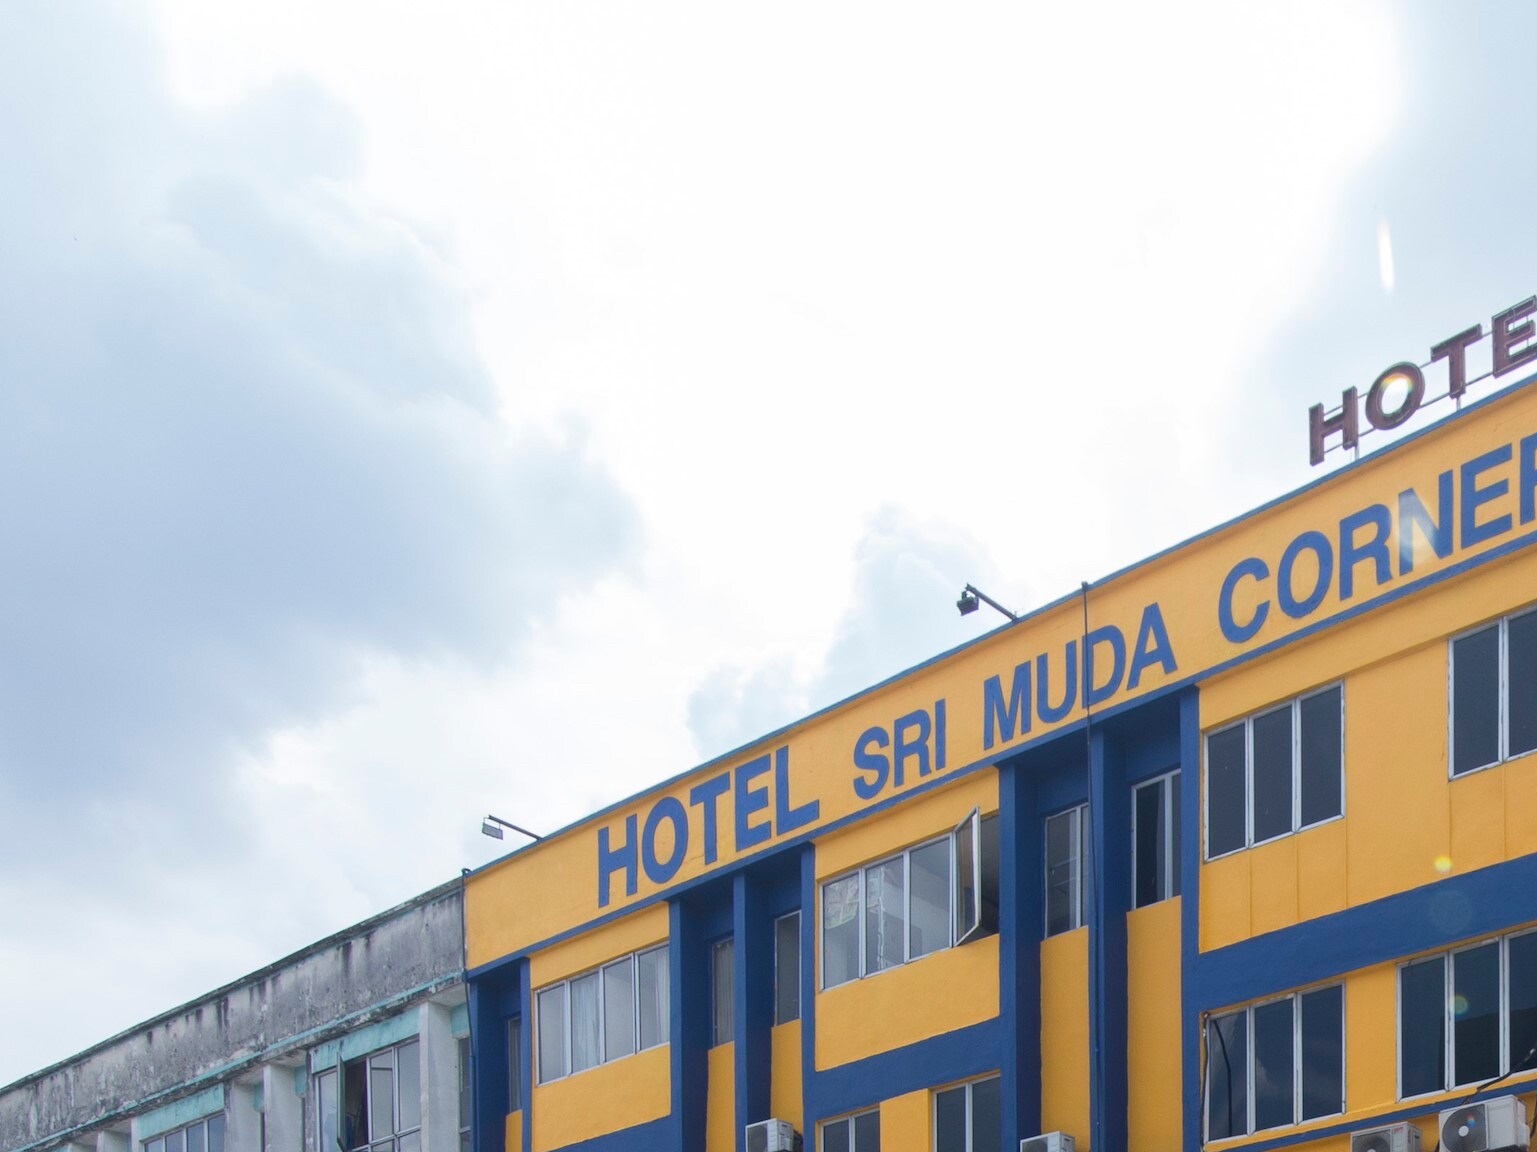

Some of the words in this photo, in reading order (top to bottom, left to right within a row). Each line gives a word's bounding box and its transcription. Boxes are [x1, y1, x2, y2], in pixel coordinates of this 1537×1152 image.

[598, 745, 820, 909] HOTEL
[851, 698, 947, 800] SRI
[982, 602, 1179, 751] MUDA
